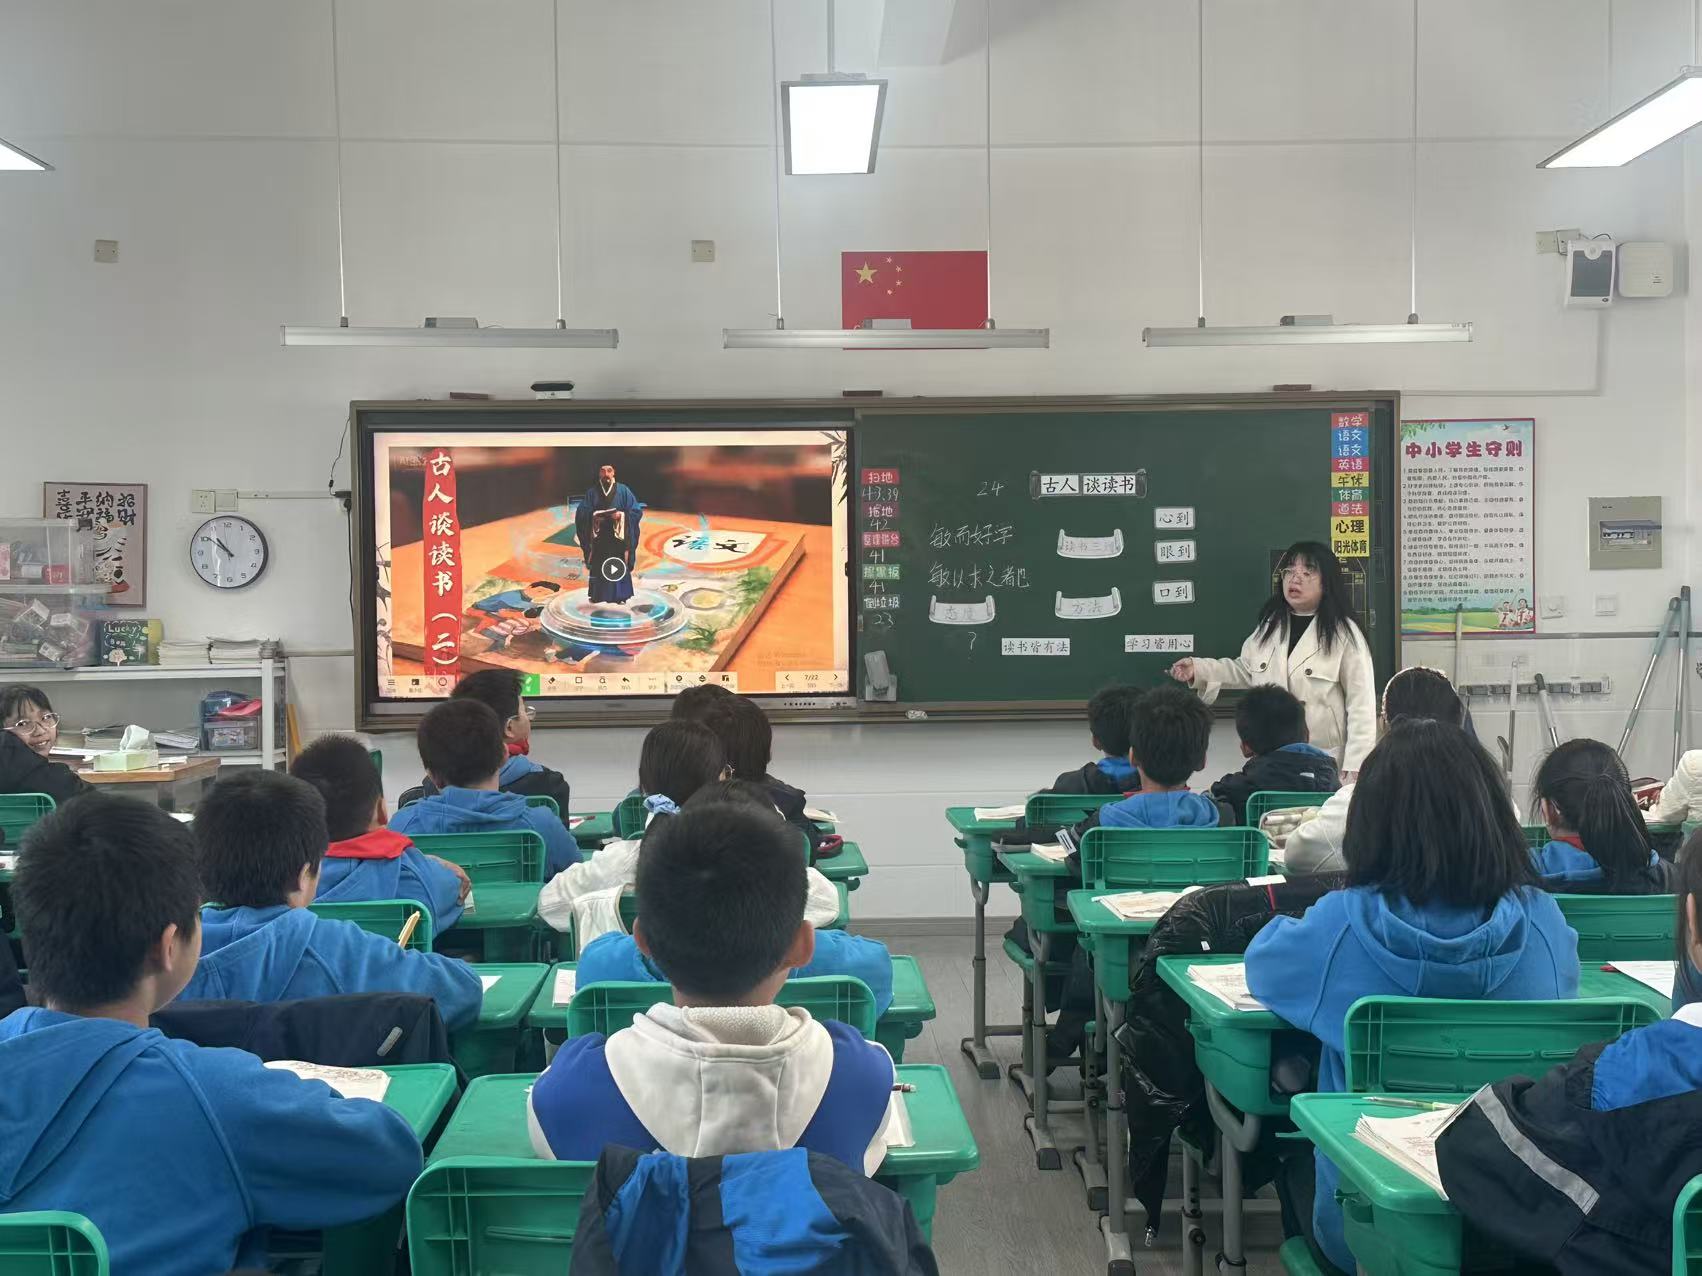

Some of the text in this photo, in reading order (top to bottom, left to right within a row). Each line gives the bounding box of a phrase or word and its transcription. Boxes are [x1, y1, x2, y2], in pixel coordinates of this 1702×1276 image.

[1338, 415, 1363, 428] 数学
[1338, 429, 1362, 442] 语文
[1338, 444, 1362, 457] 语文
[1405, 440, 1523, 459] 中小学生守则
[1338, 459, 1363, 471] 英语
[868, 471, 894, 484] 扫地
[1338, 474, 1364, 487] 午休
[977, 481, 1004, 497] 24
[1043, 477, 1135, 494] 古人谈读书
[1338, 489, 1363, 502] 体育
[75, 491, 95, 519] 平安
[868, 503, 894, 518] 拖地
[1338, 503, 1363, 515] 道法
[870, 518, 891, 531] 42
[1158, 511, 1190, 527] 心到
[1336, 519, 1365, 534] 心理
[1160, 543, 1191, 559] 眼到
[1333, 539, 1368, 555] 阳光体育
[869, 549, 885, 563] 41
[869, 579, 885, 594] 41
[1159, 585, 1189, 600] 口到
[863, 597, 900, 609] 倒垃圾
[1071, 599, 1103, 614] 方法
[873, 611, 895, 630] 23
[109, 624, 138, 634] Lucky
[1003, 641, 1069, 655] 读书皆有法
[1127, 637, 1192, 651] 学习皆用心
